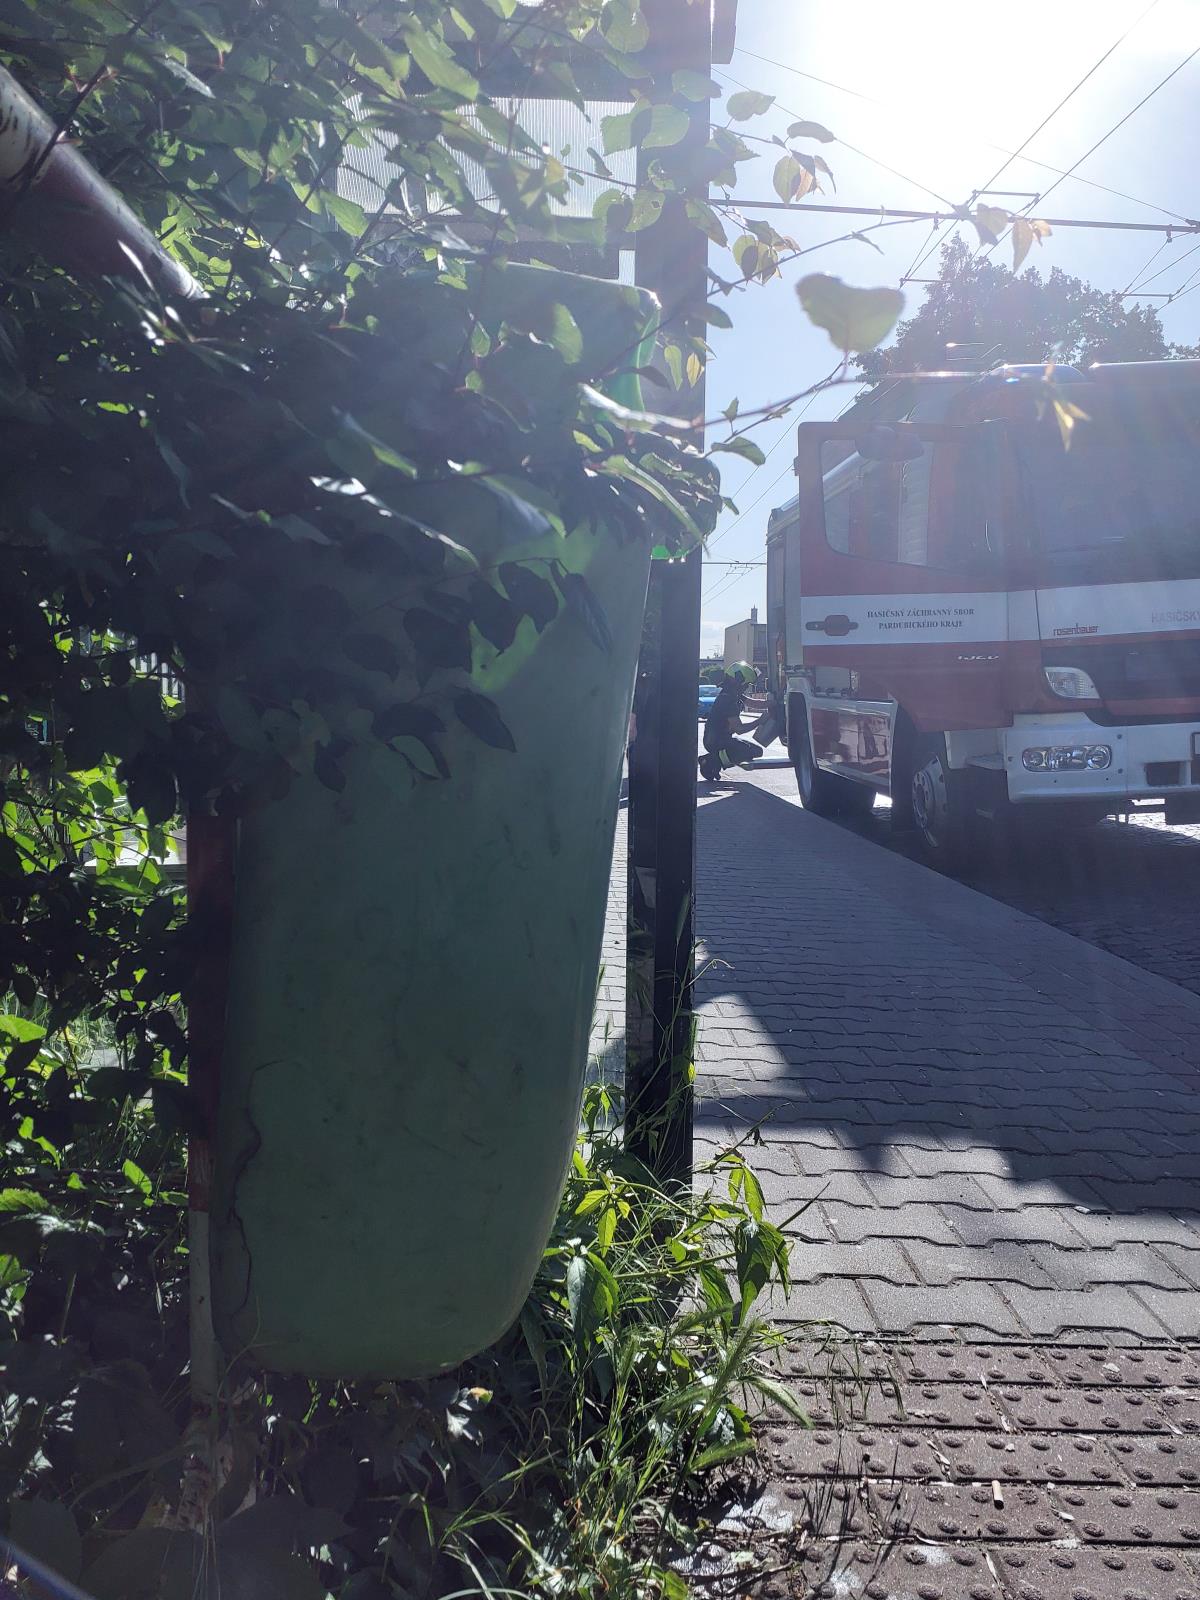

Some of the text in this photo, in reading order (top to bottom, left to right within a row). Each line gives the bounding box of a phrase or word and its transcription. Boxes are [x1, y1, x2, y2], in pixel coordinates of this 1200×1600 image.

[953, 608, 974, 616] SBOR
[940, 620, 962, 628] KRAJE
[1053, 623, 1098, 636] rosenbauer
